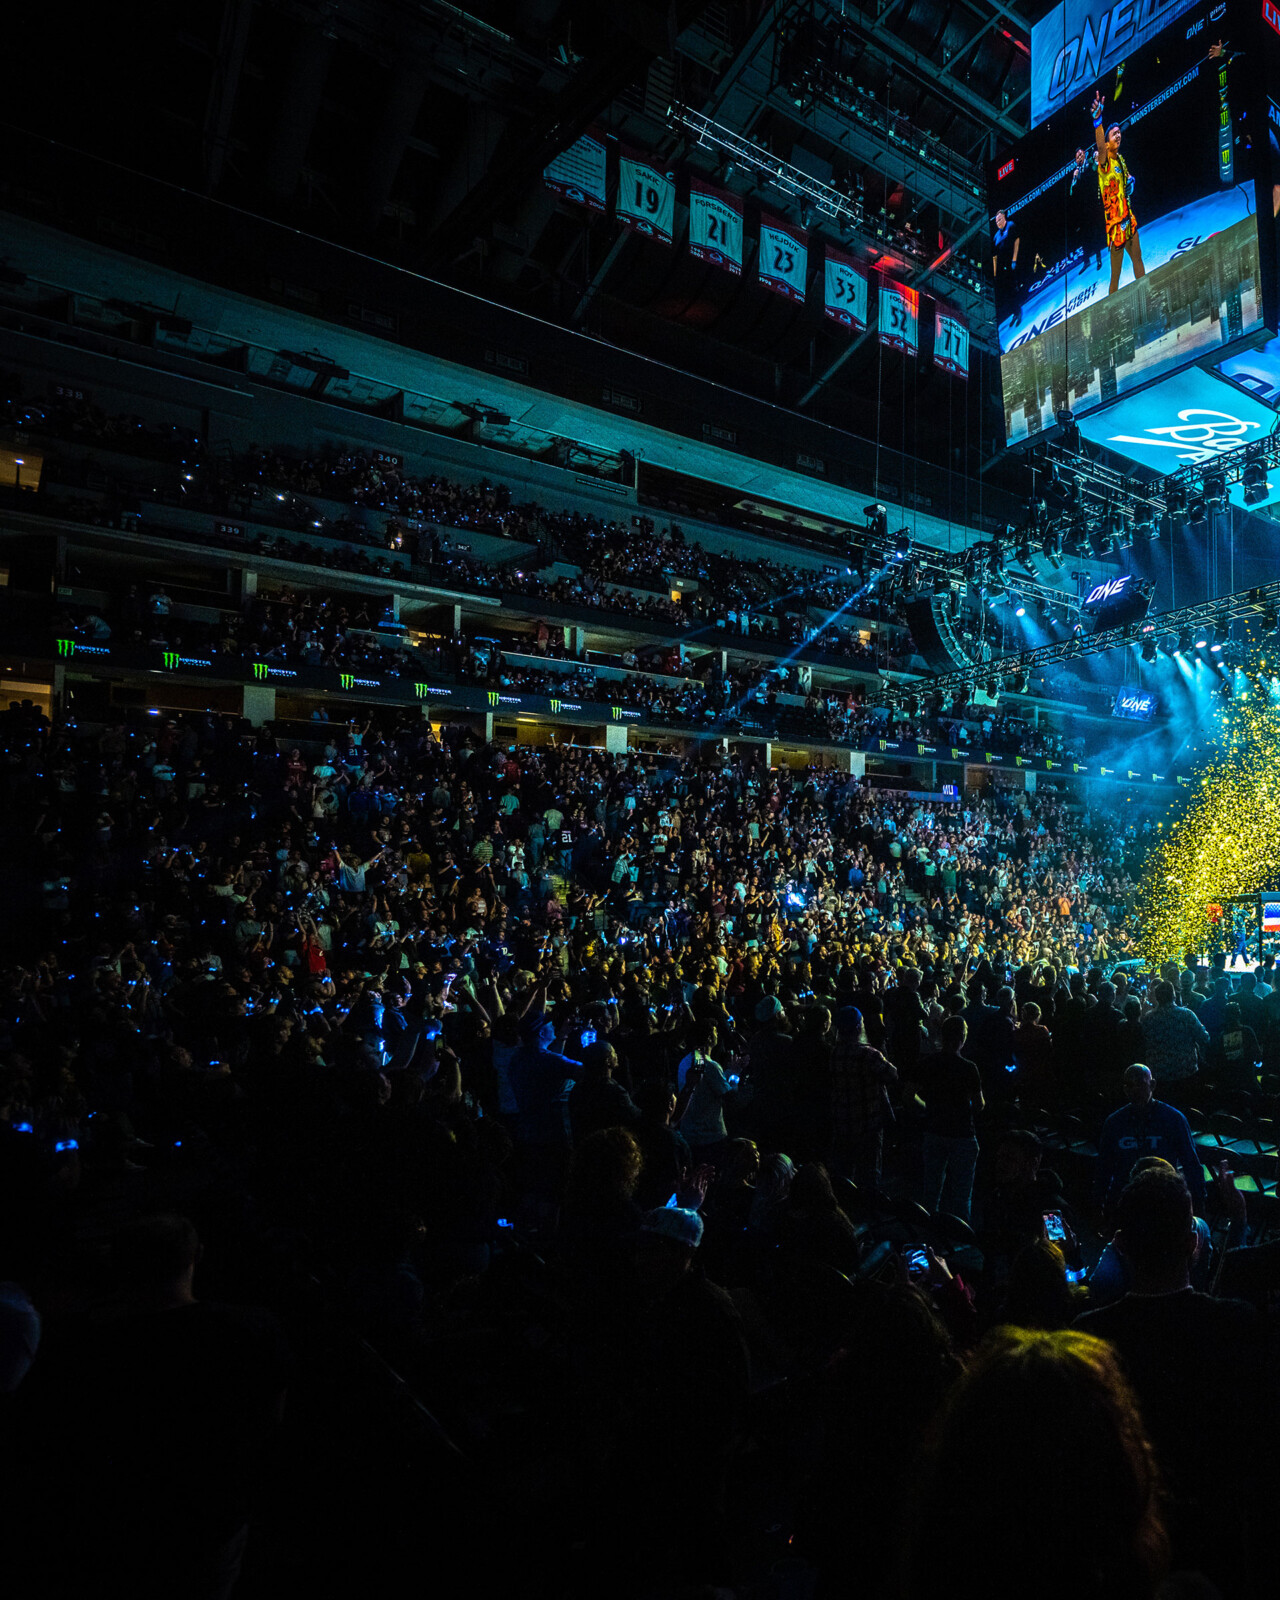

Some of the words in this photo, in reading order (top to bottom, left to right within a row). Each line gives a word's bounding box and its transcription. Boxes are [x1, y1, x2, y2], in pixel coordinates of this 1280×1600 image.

[1186, 18, 1204, 40] ONE
[1210, 2, 1227, 19] prime
[1131, 67, 1199, 125] MONSTERENERGY.COM
[635, 168, 660, 185] SAKIC
[999, 161, 1013, 178] LIVE
[635, 181, 659, 214] 19
[695, 199, 738, 224] FORSBERG
[708, 213, 726, 247] 21
[769, 233, 800, 253] HEJDUK
[774, 245, 794, 273] 23
[840, 268, 853, 278] ROY
[836, 277, 856, 303] 33
[1067, 290, 1097, 313] NIGHT
[1068, 281, 1098, 307] FIGHT
[891, 306, 907, 331] 52
[1008, 305, 1066, 353] ONE
[944, 328, 961, 355] 77
[377, 453, 398, 464] 340
[219, 525, 240, 536] 339
[1086, 575, 1131, 604] ONE
[1121, 698, 1151, 712] ONE
[348, 748, 358, 756] 21
[561, 833, 573, 843] 21
